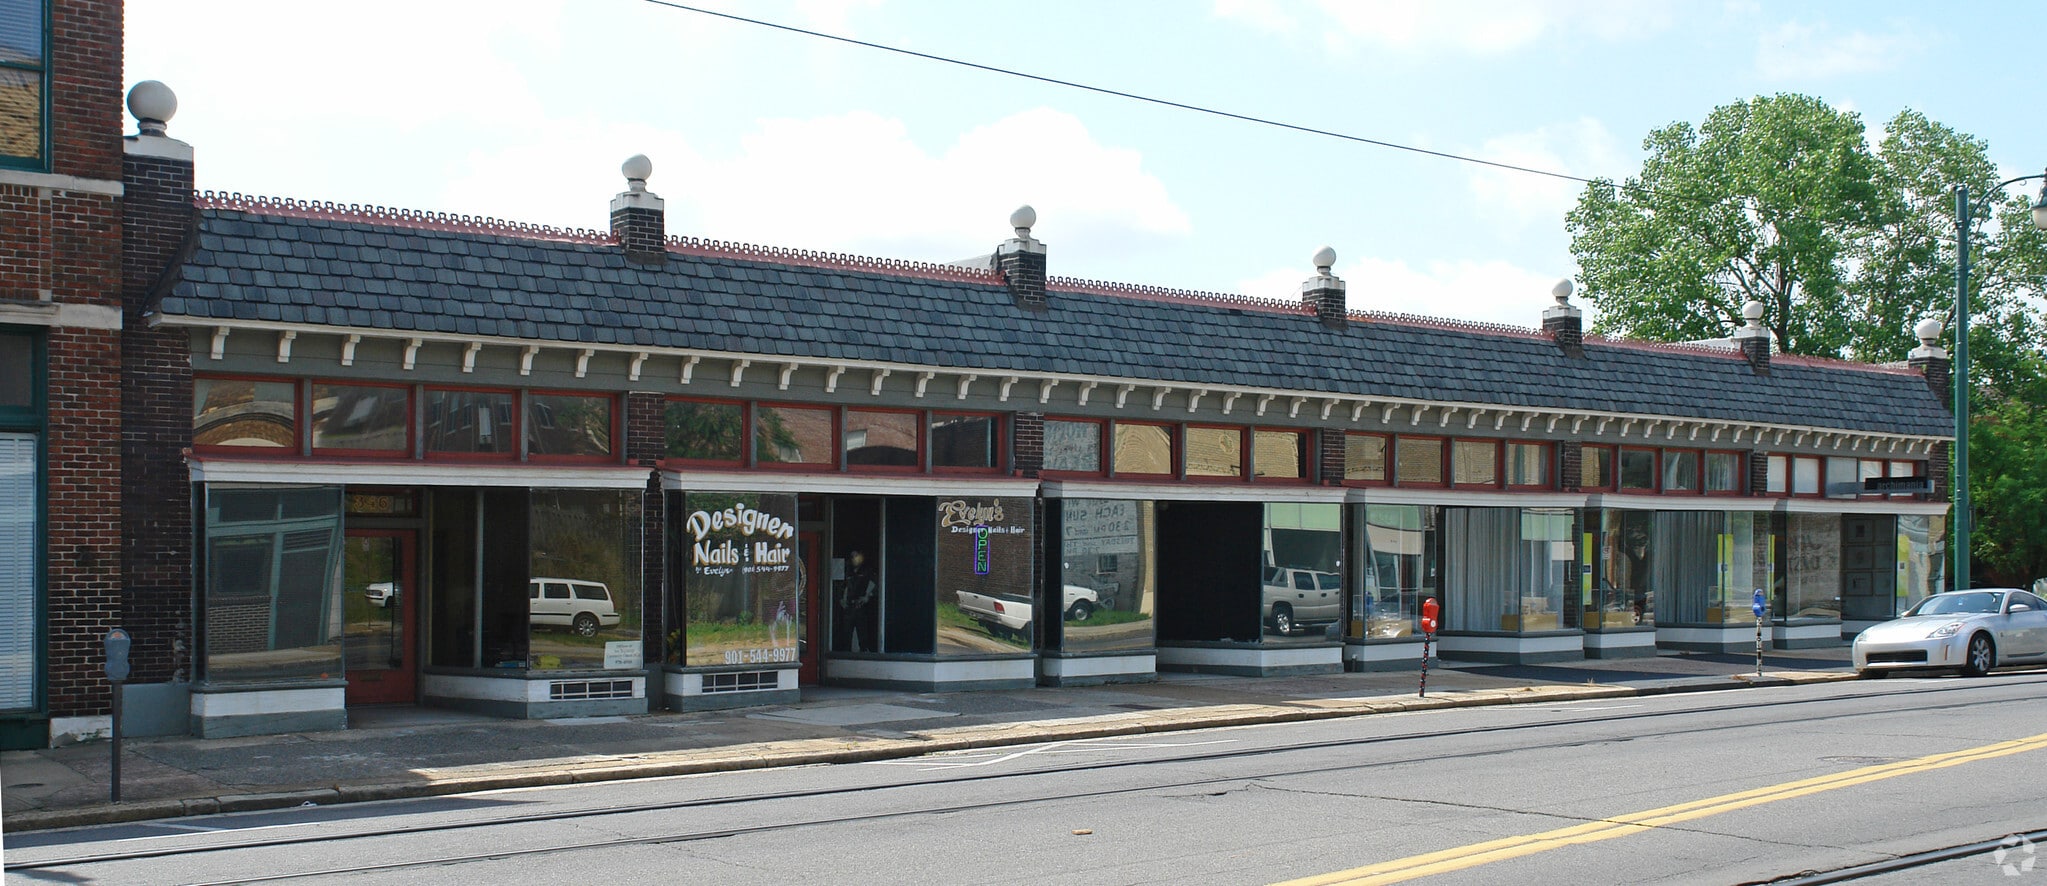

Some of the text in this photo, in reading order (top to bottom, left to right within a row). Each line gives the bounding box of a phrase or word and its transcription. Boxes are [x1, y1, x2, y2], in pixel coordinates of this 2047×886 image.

[686, 503, 794, 541] Designer
[939, 498, 1004, 527] Evelyn's
[693, 540, 739, 566] Nails
[754, 541, 791, 566] Hair
[977, 527, 988, 572] OPEN
[725, 647, 796, 665] 901-544-9977
